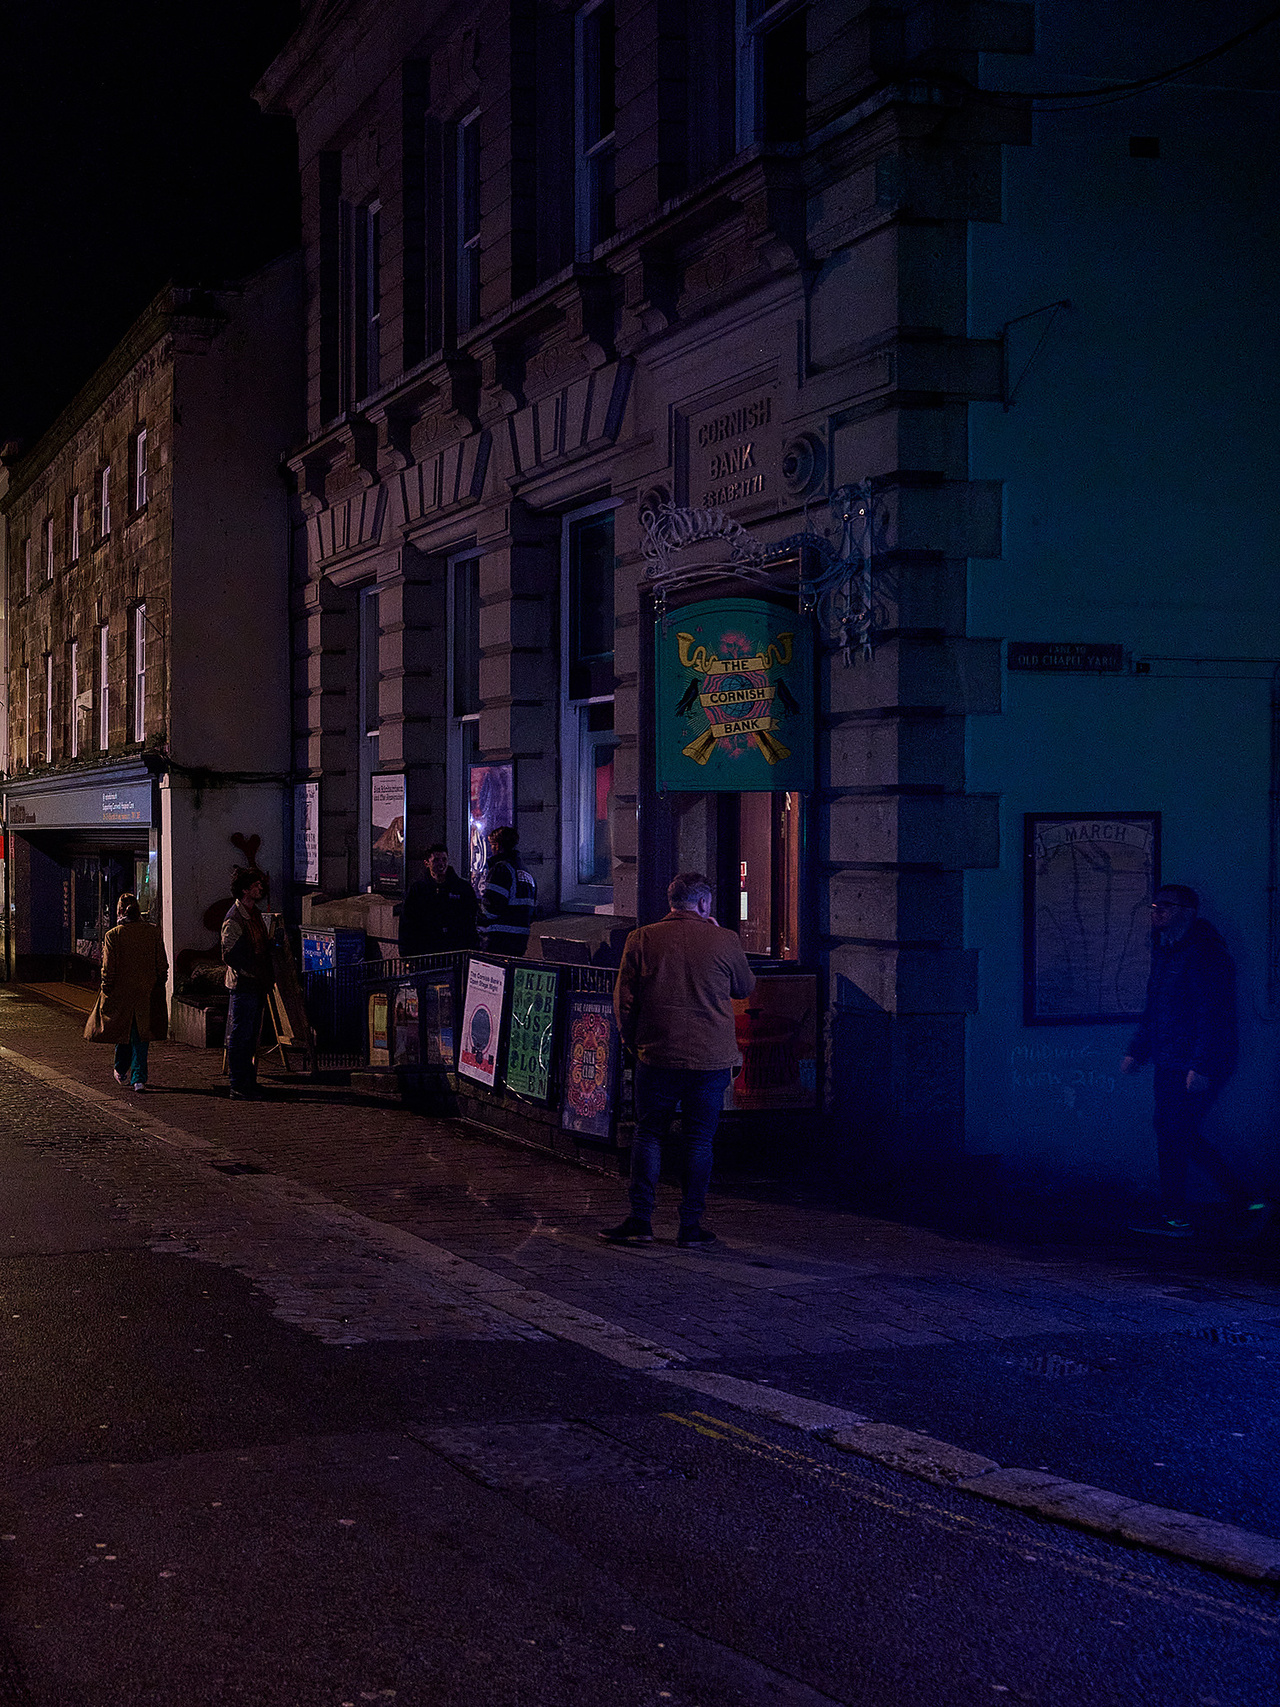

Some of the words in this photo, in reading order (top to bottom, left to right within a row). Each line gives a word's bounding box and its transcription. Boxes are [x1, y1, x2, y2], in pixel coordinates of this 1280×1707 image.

[699, 397, 771, 448] CORNISH
[710, 442, 755, 481] BANK
[722, 660, 749, 672] THE
[1018, 654, 1039, 666] OLD
[1042, 654, 1081, 666] CHAPEL
[710, 689, 765, 703] CORNISH
[724, 719, 759, 734] BANK
[1065, 824, 1126, 842] MARCH
